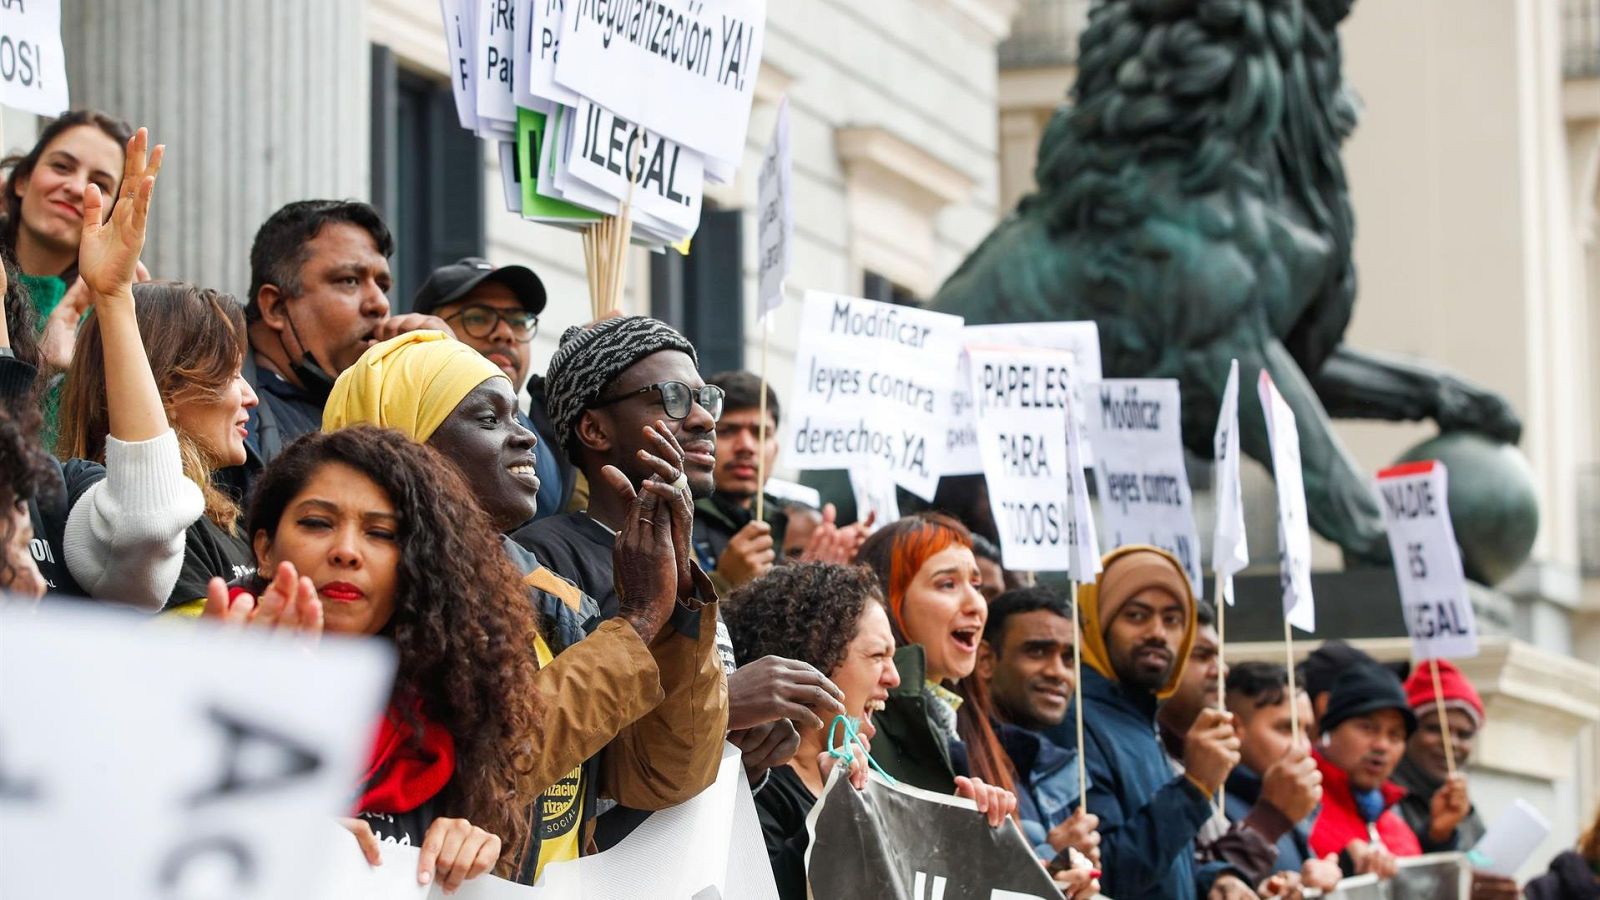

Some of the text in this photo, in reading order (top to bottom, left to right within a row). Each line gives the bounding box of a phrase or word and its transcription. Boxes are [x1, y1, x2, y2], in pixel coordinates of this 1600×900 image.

[717, 14, 754, 92] YA!
[582, 102, 691, 207] ILEGAL.
[830, 299, 933, 349] Modificar
[807, 355, 862, 403] leyes
[868, 371, 936, 414] contra
[546, 808, 576, 834] SOCIAL
